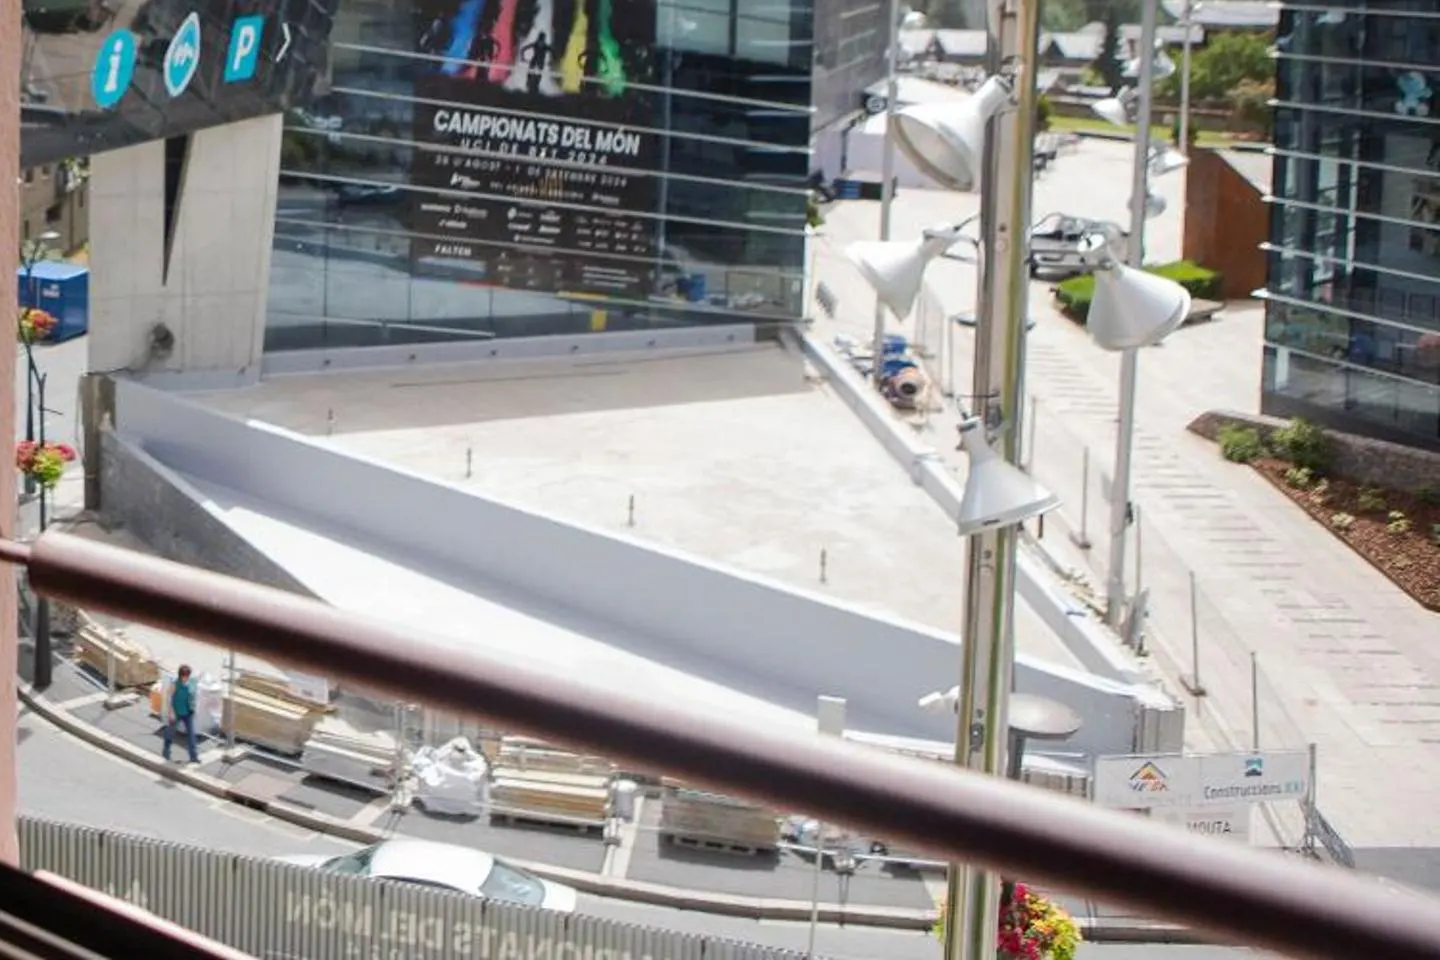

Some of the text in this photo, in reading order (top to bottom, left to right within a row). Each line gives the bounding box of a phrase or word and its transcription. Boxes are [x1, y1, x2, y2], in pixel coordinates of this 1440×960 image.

[232, 24, 256, 71] P
[433, 109, 640, 156] CAMPIONATS DEL MÓN
